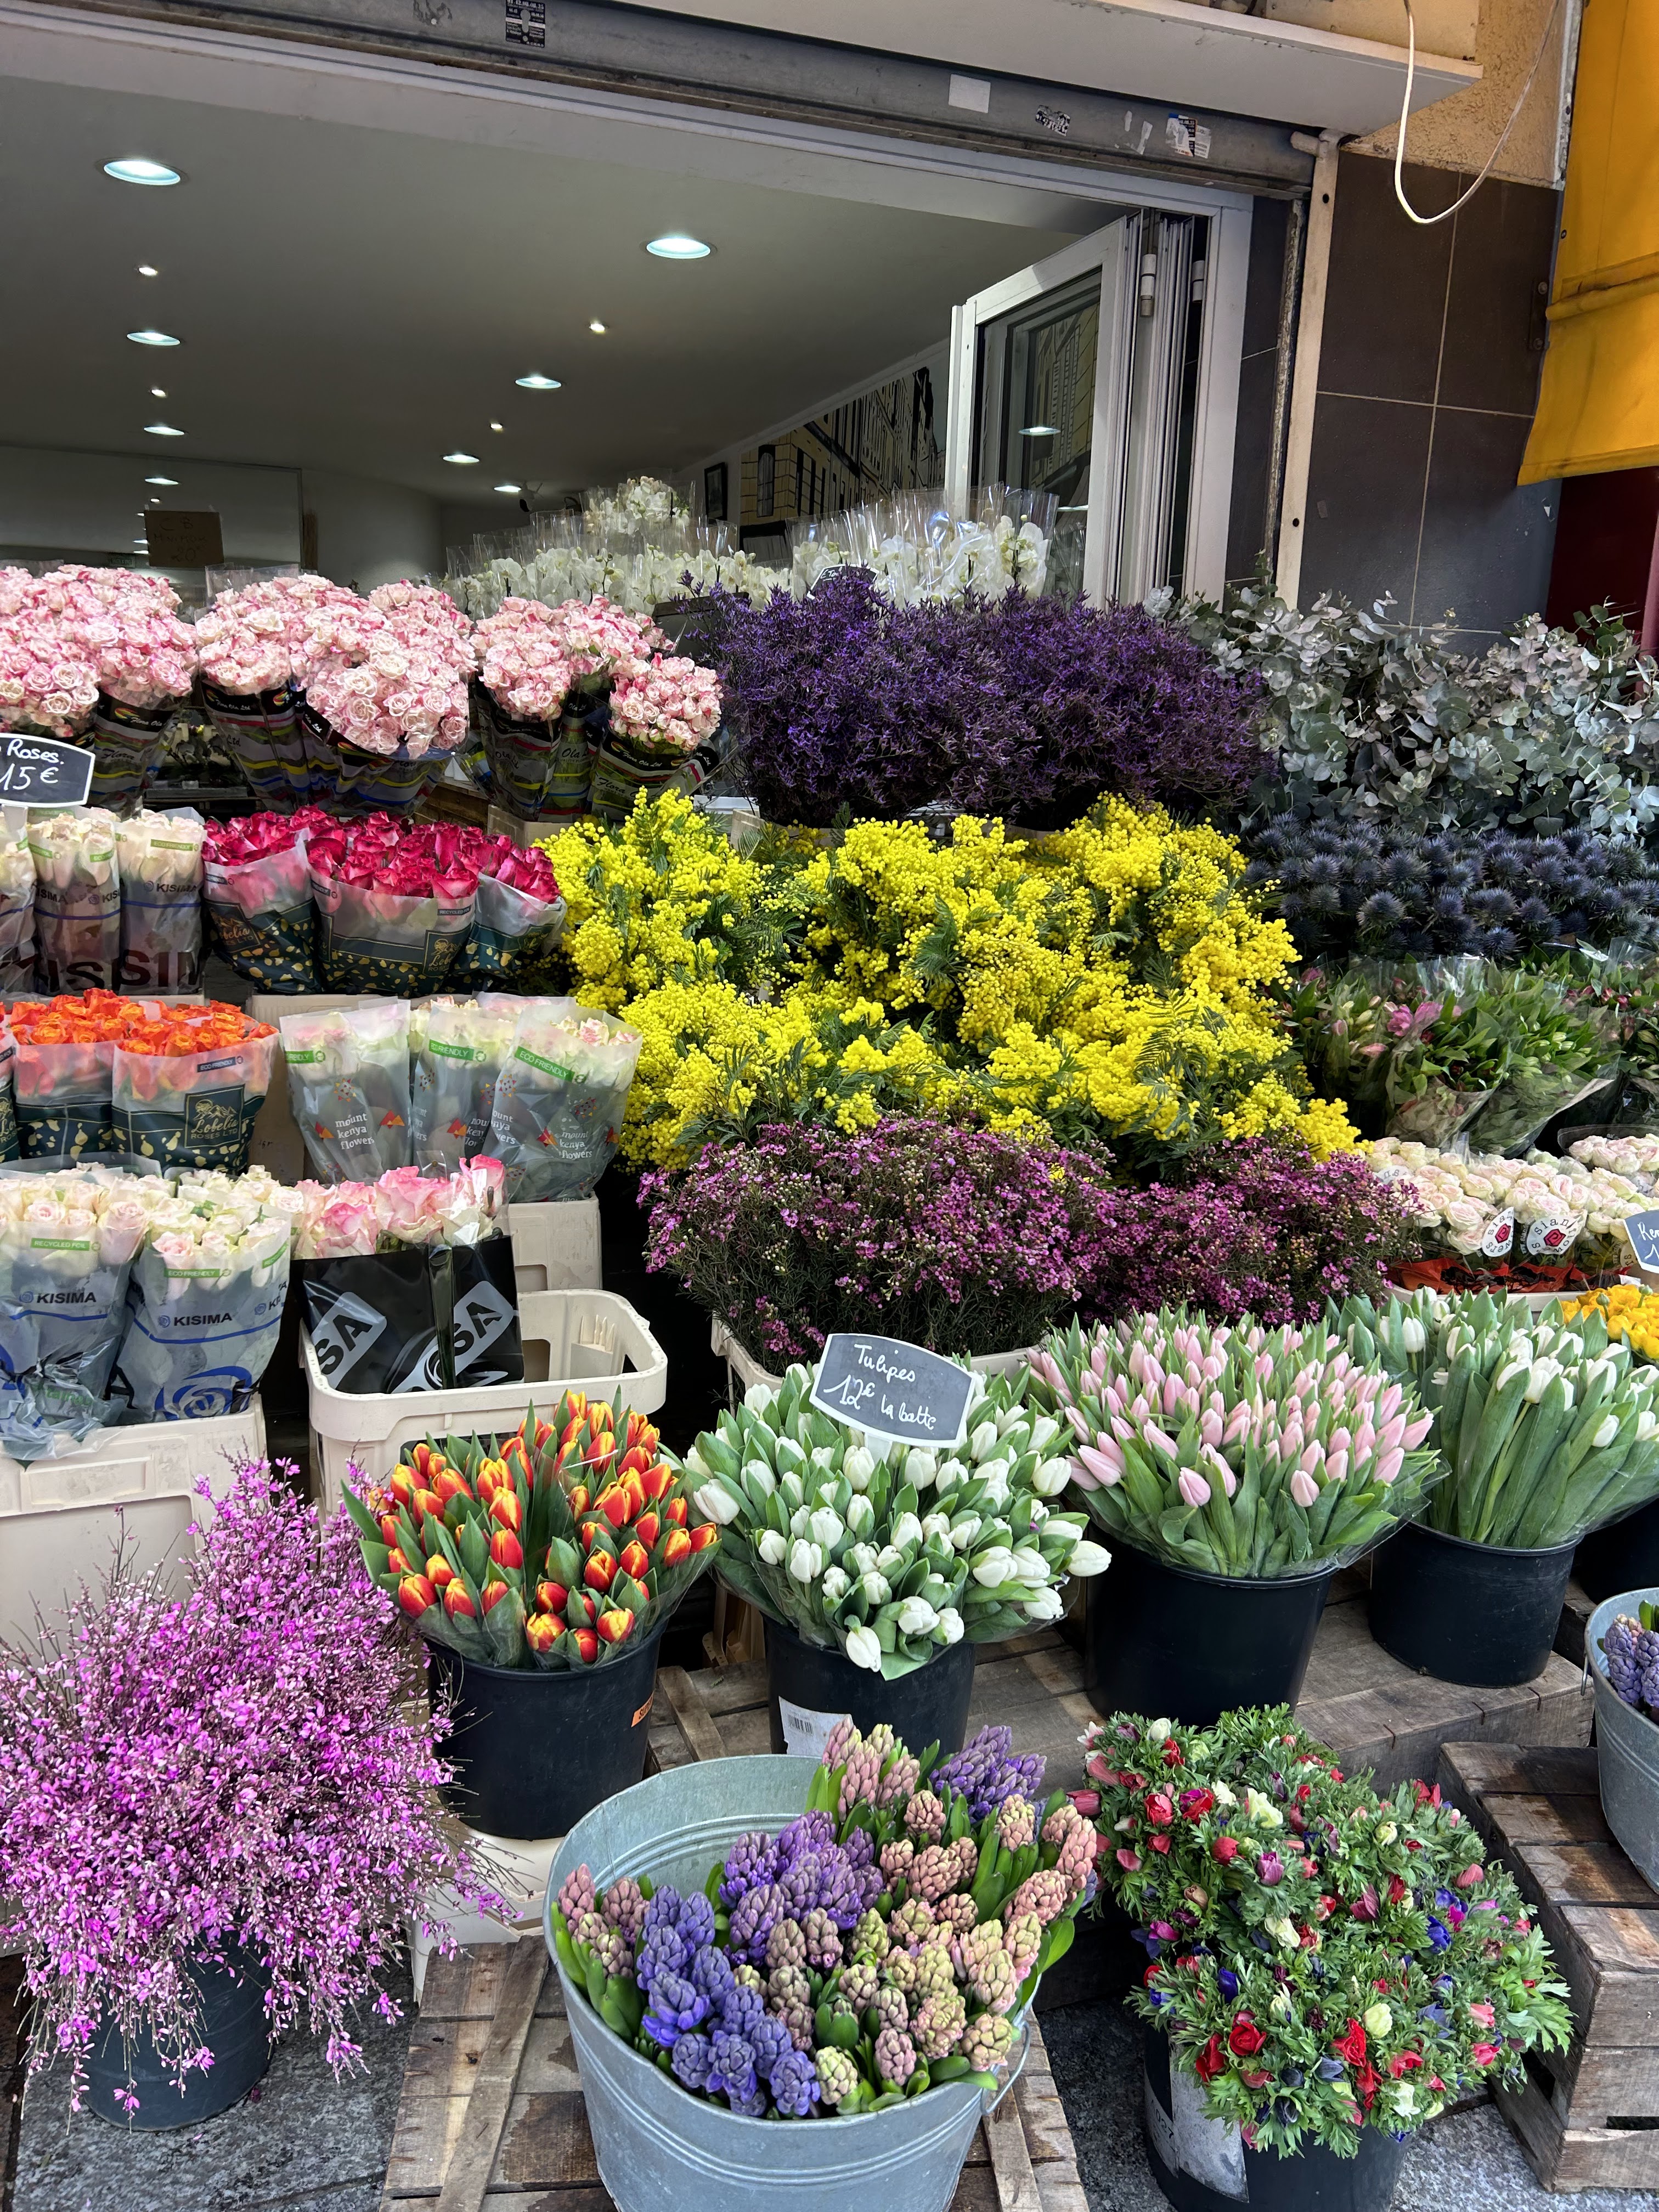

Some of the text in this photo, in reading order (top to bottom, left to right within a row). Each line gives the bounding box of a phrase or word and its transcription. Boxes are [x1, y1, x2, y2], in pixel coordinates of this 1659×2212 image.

[562, 748, 580, 758] Ola
[596, 777, 626, 794] Flora
[156, 883, 198, 893] KISIMA
[102, 889, 120, 903] KIS
[438, 1046, 469, 1058] FRIENDLY
[519, 1050, 569, 1077] ECO FRIENDLY
[335, 1113, 368, 1128] mount
[493, 1110, 514, 1122] ount
[191, 1115, 238, 1133] Lobelia
[337, 1126, 368, 1139] kenya
[561, 1130, 588, 1138] mount
[340, 1136, 375, 1150] flowers
[559, 1139, 585, 1149] kenya
[561, 1149, 592, 1159] flowers
[1534, 1218, 1570, 1235] sian
[34, 1240, 71, 1248] RECYCLED
[37, 1291, 97, 1304] KISIMA
[173, 1312, 233, 1326] KISIMA
[854, 1344, 916, 1383] Tulipes
[881, 1394, 894, 1420] la
